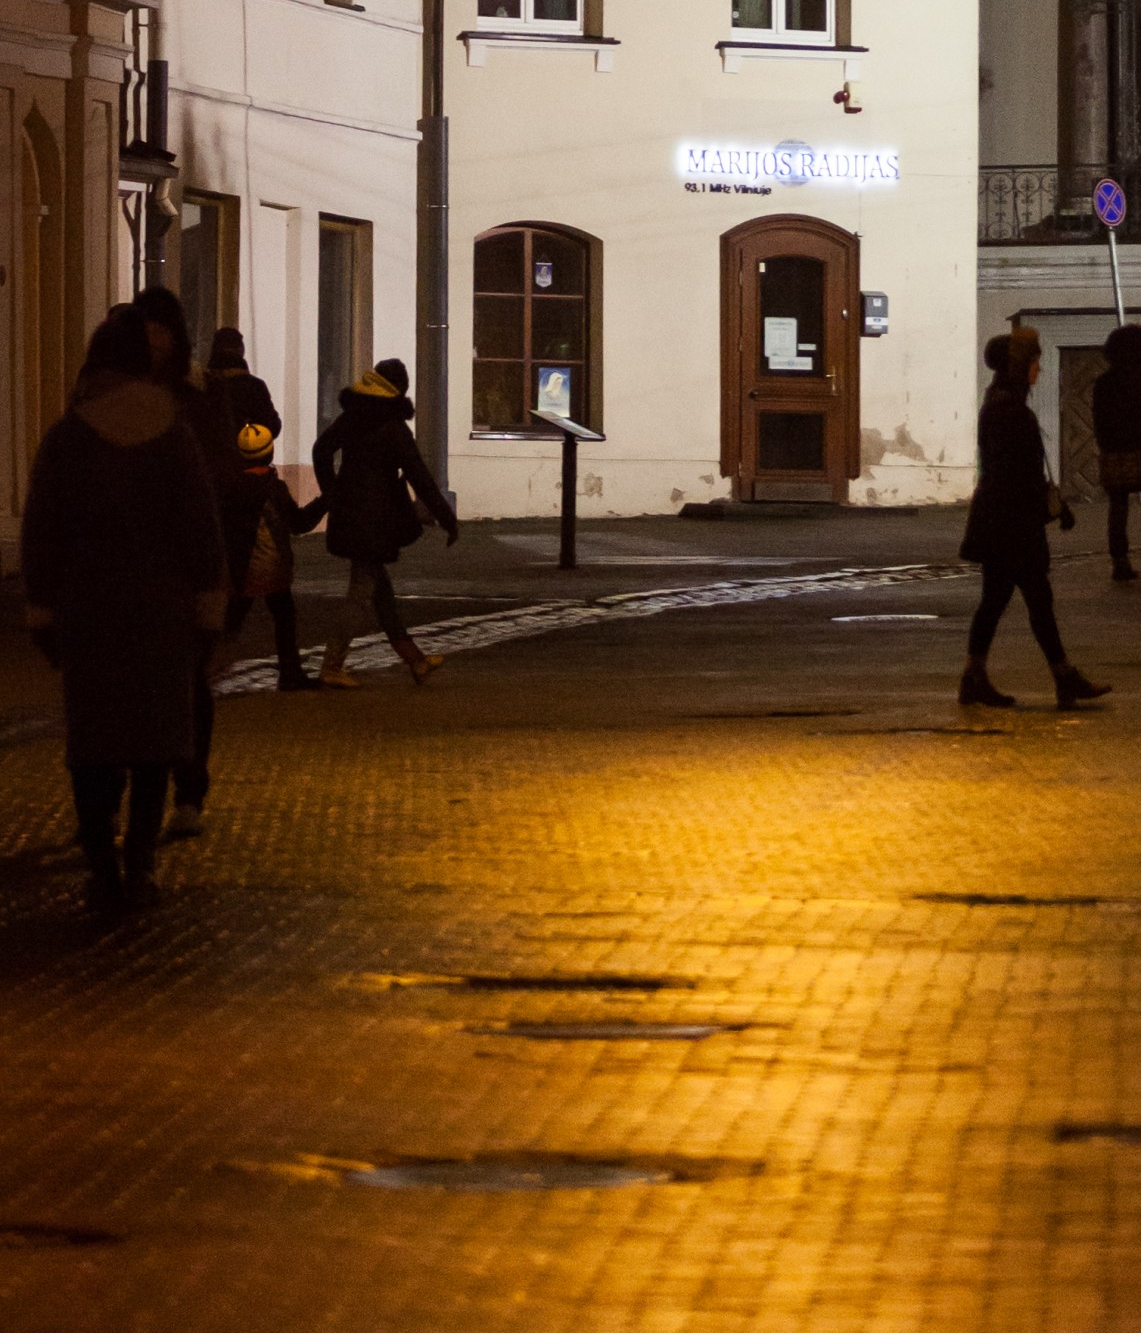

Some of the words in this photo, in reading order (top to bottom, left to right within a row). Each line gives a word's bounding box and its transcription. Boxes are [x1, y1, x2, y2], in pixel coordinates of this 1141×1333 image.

[687, 148, 792, 180] MARIJOS
[801, 153, 900, 182] RADIJAS
[684, 182, 705, 193] 93.1
[709, 183, 731, 194] MHz
[733, 184, 772, 196] Vilniuje
